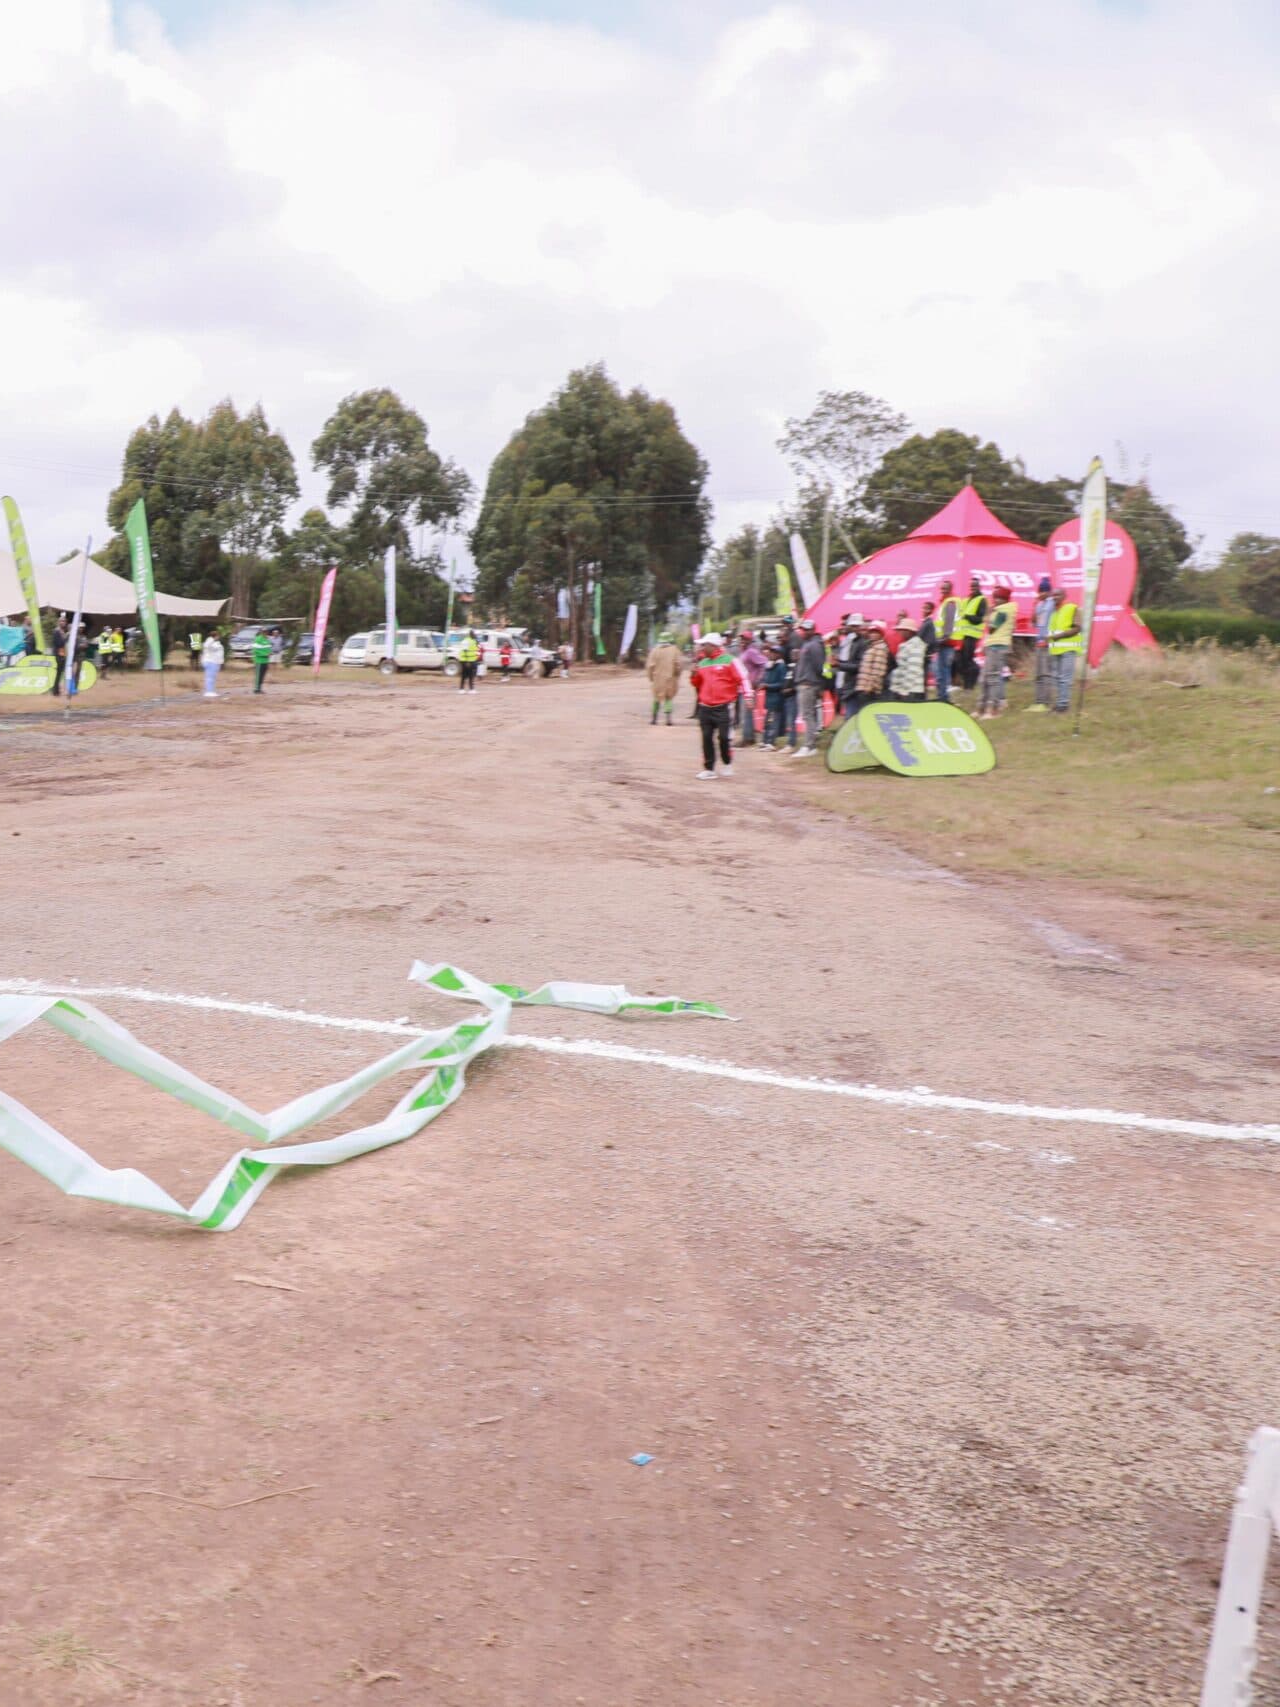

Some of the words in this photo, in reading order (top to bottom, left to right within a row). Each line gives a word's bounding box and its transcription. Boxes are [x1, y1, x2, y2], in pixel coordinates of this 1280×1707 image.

[1054, 538, 1123, 561] DB
[849, 574, 912, 591] DTB
[915, 727, 977, 754] KCB
